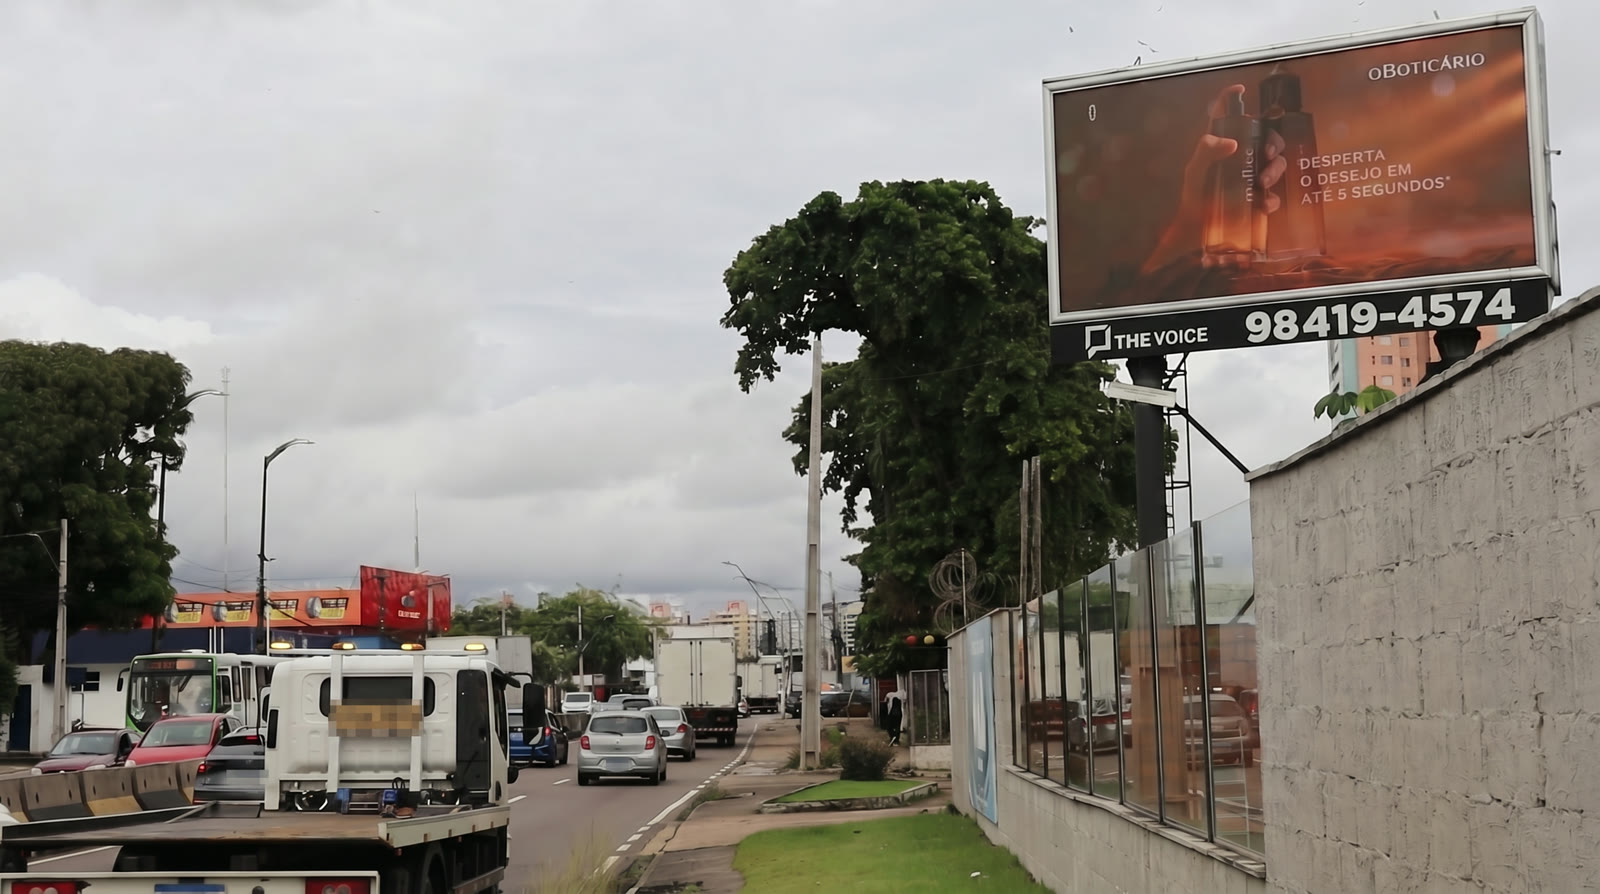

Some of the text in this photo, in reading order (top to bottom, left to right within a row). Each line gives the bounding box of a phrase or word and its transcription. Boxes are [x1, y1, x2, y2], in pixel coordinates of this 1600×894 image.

[1300, 149, 1386, 170] DESPERTA
[1300, 163, 1412, 188] O DESEJO EM
[1301, 187, 1334, 205] ATÉ
[1338, 188, 1347, 200] 5
[1245, 287, 1516, 343] 98419-4574
[1114, 327, 1209, 350] THE VOICE
